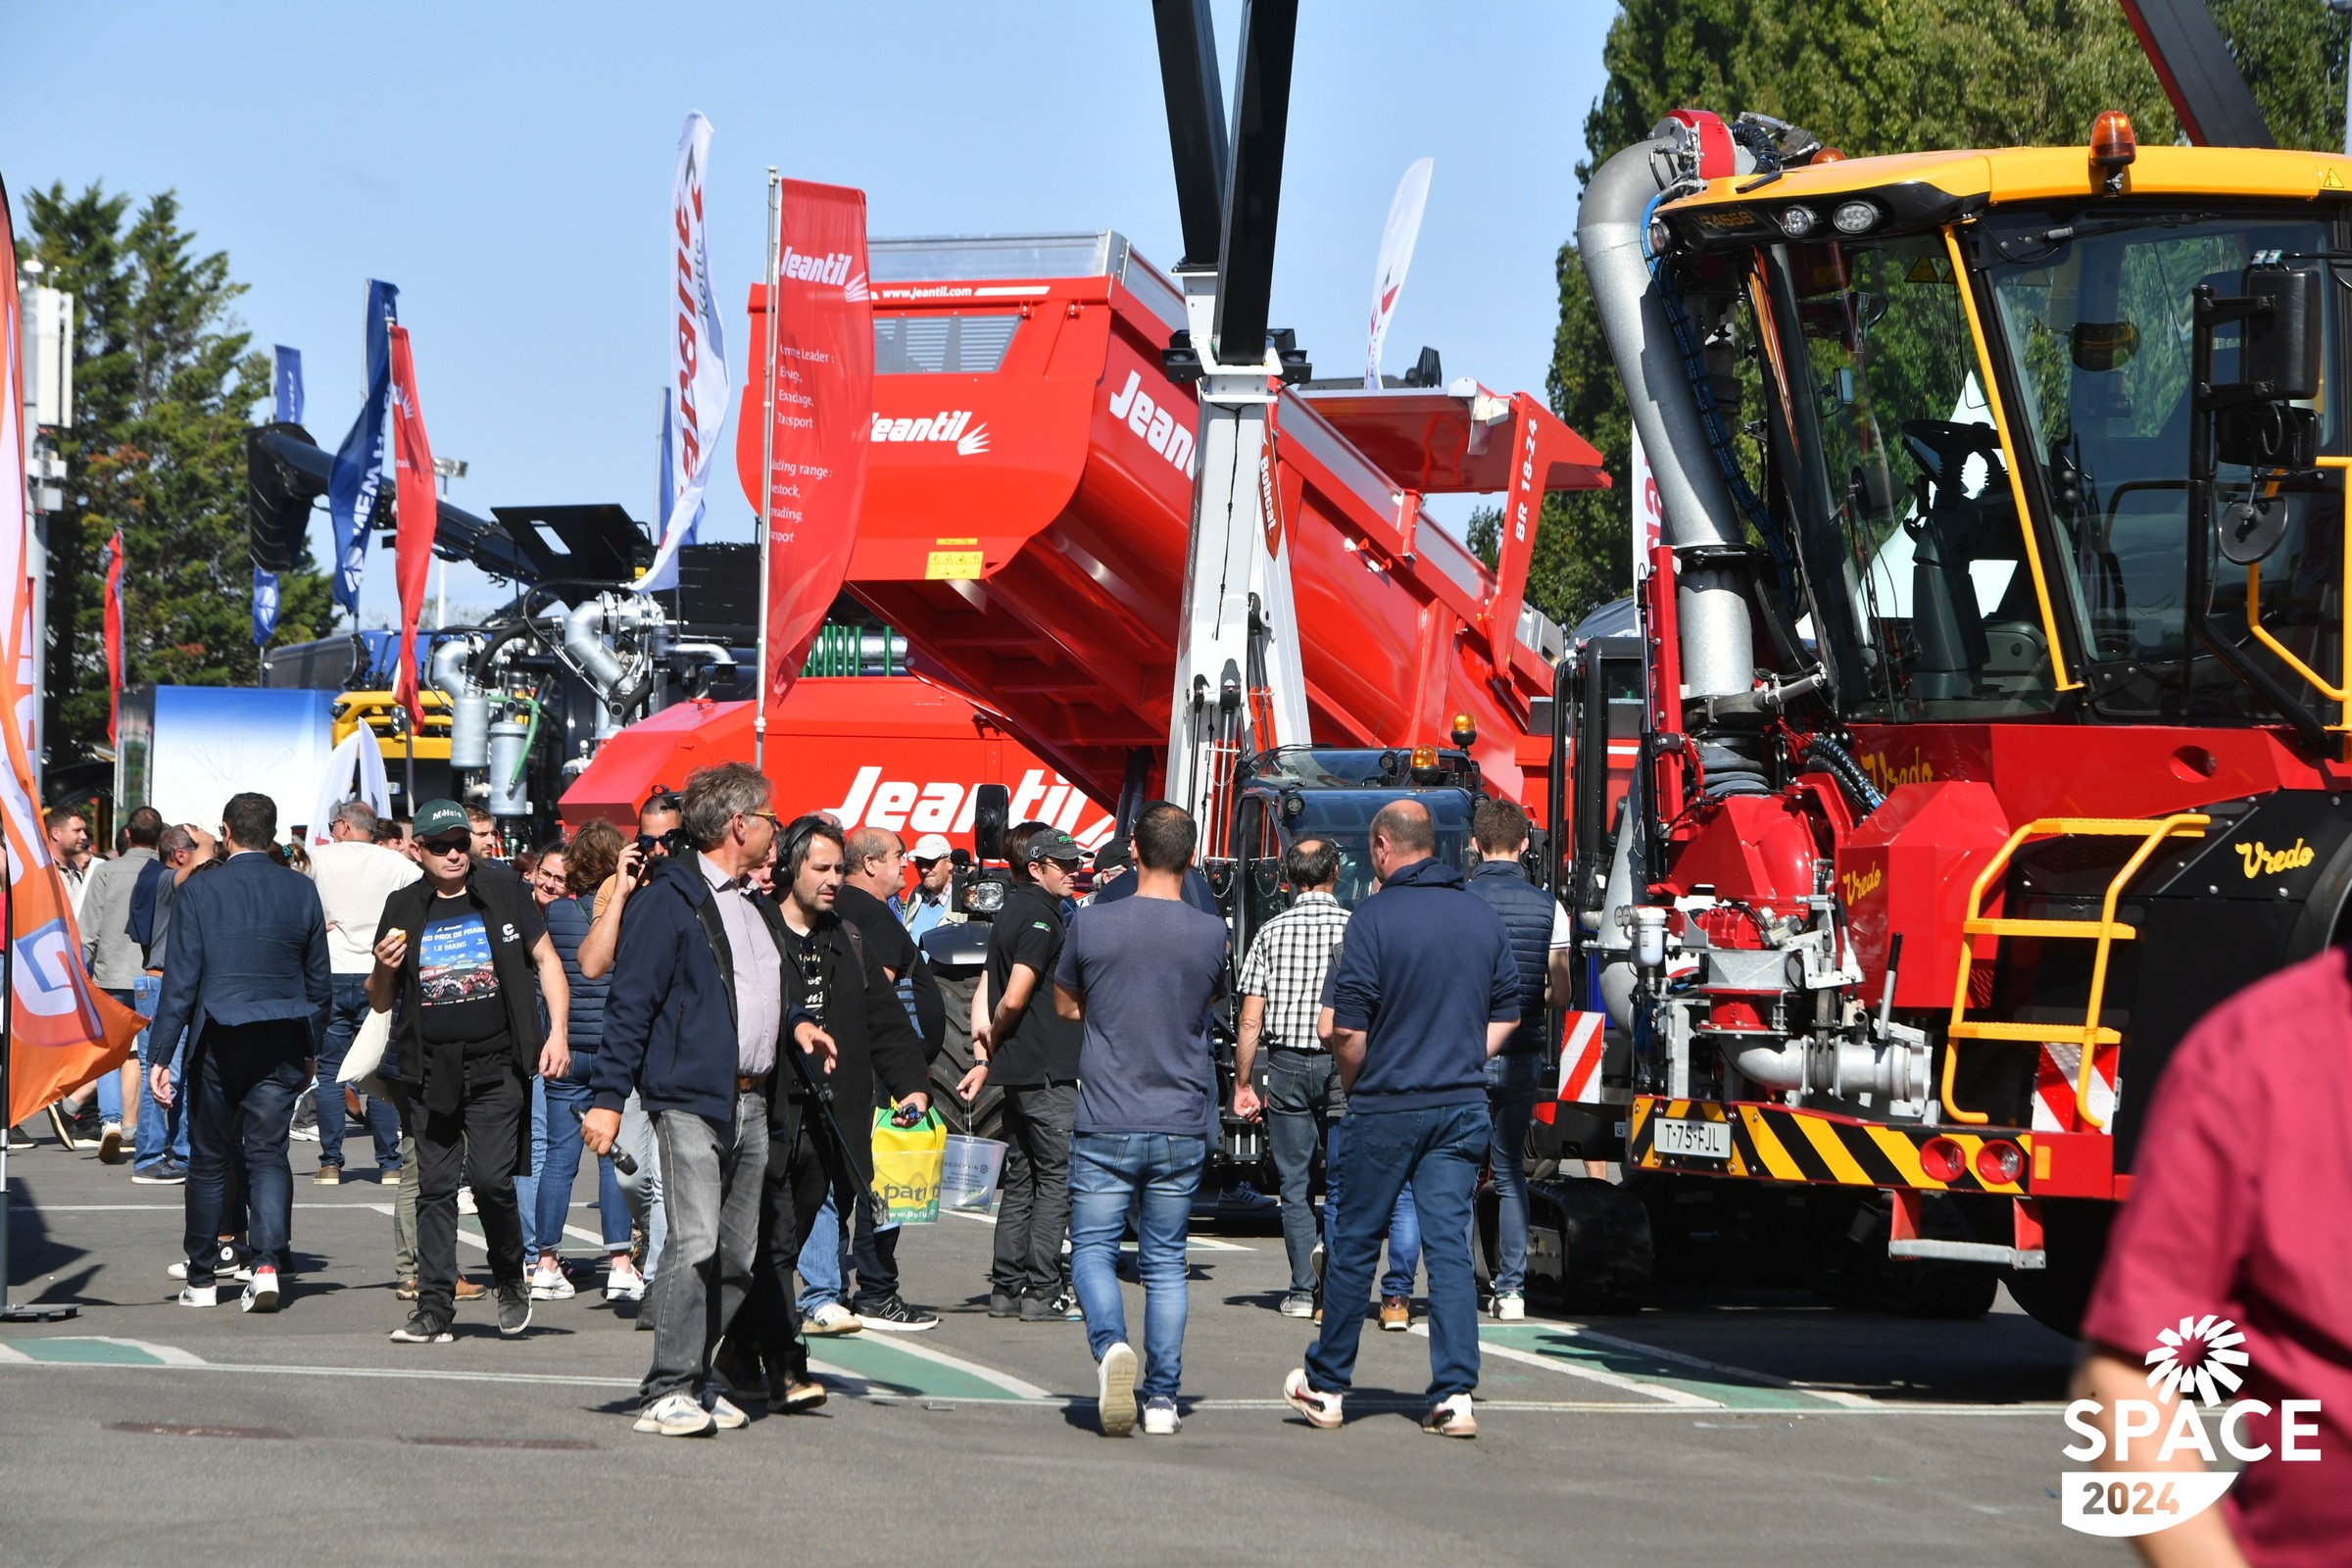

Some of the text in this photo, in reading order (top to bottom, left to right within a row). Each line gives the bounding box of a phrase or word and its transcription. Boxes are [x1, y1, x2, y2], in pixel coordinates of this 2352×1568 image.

[881, 286, 972, 300] www.jeantil.com
[1521, 417, 1538, 492] 18-24
[1260, 455, 1276, 531] Bobcat
[1515, 501, 1528, 543] BR
[2234, 837, 2315, 879] Vredo
[1842, 860, 1882, 906] Vredo
[434, 933, 452, 942] PRIX
[444, 941, 467, 951] MANS
[944, 1161, 979, 1171] OODCHAIN
